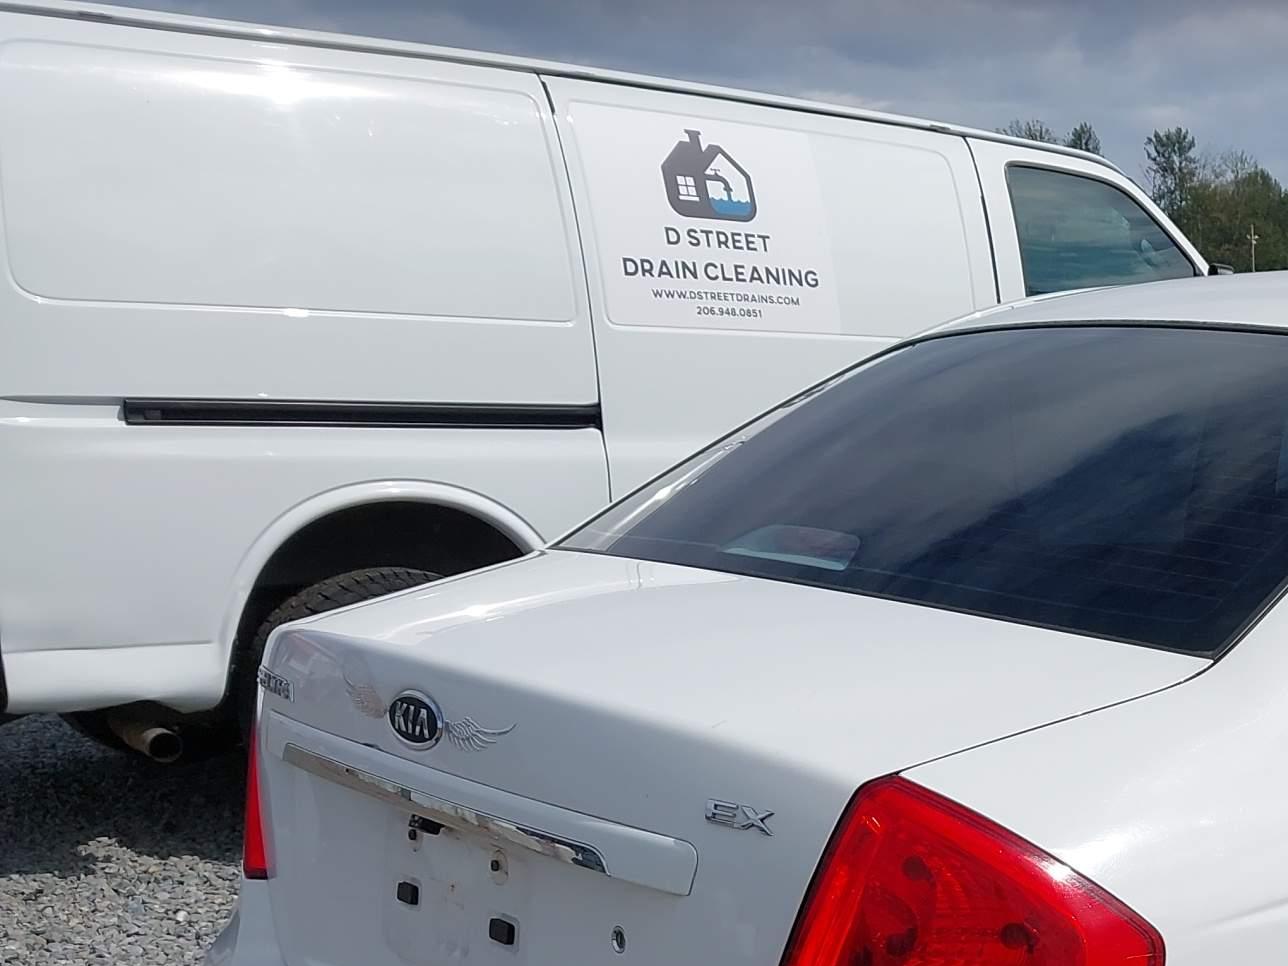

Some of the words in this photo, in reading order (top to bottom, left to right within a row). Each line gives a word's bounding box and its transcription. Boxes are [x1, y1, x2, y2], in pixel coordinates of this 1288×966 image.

[664, 227, 681, 246] D
[686, 228, 770, 252] STREET
[622, 257, 699, 280] DRAIN
[703, 262, 819, 288] CLEANING
[651, 289, 800, 306] WWW.DSTREETDRAINS.COM
[696, 306, 763, 318] 206.948.0851
[394, 700, 430, 739] KIA
[705, 798, 775, 837] EX
